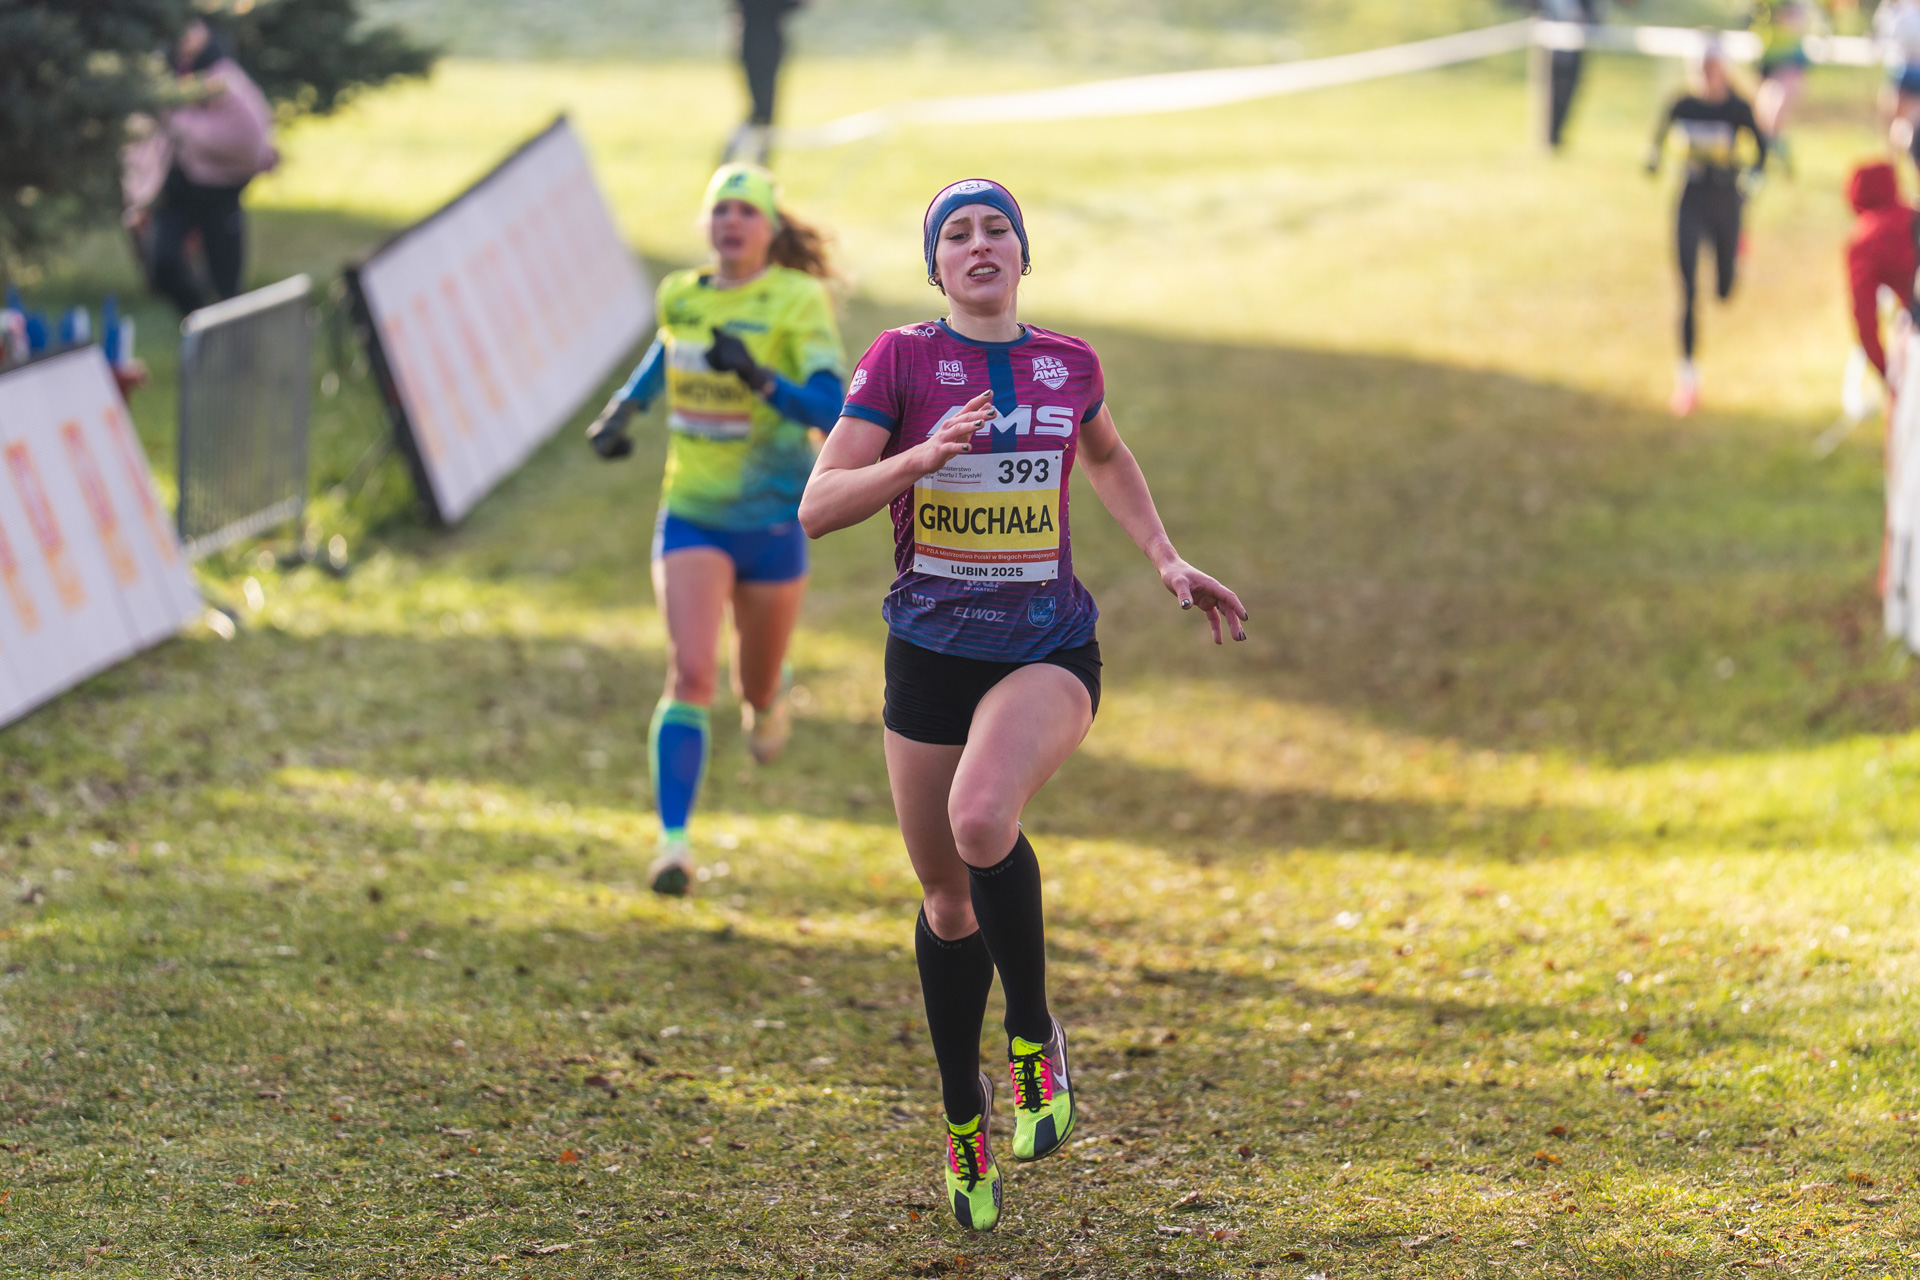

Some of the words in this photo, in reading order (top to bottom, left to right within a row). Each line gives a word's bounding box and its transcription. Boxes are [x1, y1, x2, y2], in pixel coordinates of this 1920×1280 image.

[943, 362, 960, 373] KB
[1032, 367, 1070, 382] AMS
[997, 458, 1050, 484] 393
[919, 503, 1054, 535] GRUCHAŁA
[939, 550, 973, 559] Mistrzostwa
[951, 565, 988, 577] LUBIN
[991, 567, 1024, 577] 2025
[911, 592, 937, 610] MG
[952, 605, 1007, 623] ELWOZ
